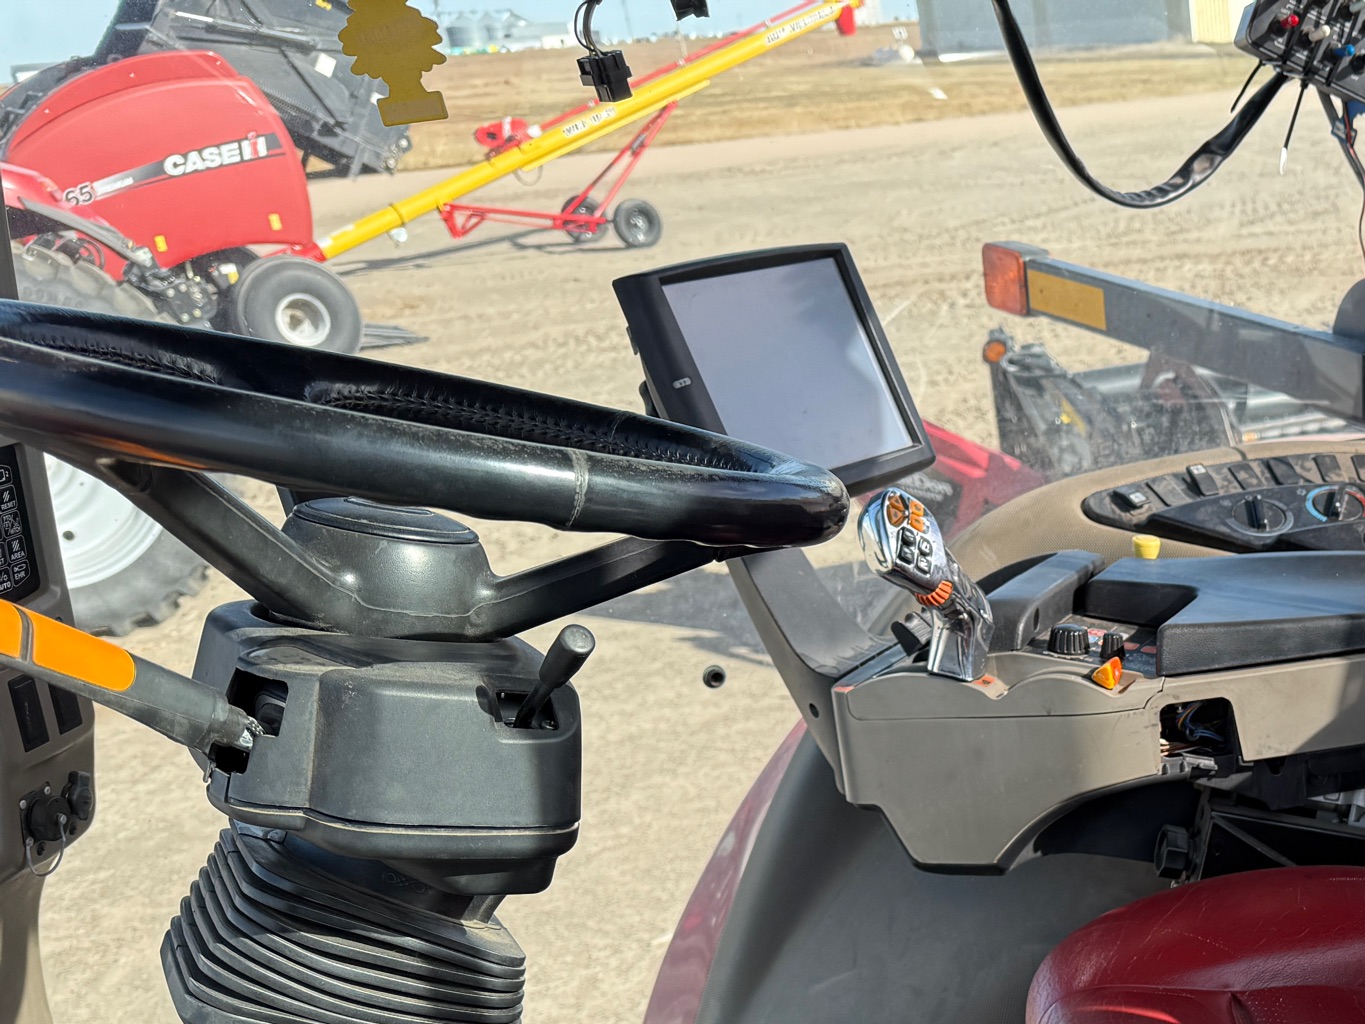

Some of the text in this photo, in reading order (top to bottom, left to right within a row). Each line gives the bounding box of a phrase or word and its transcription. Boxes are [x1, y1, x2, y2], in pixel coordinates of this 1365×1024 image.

[164, 142, 240, 176] CASE
[0, 500, 16, 510] RESET
[11, 550, 26, 560] AREA
[0, 581, 11, 590] UTO
